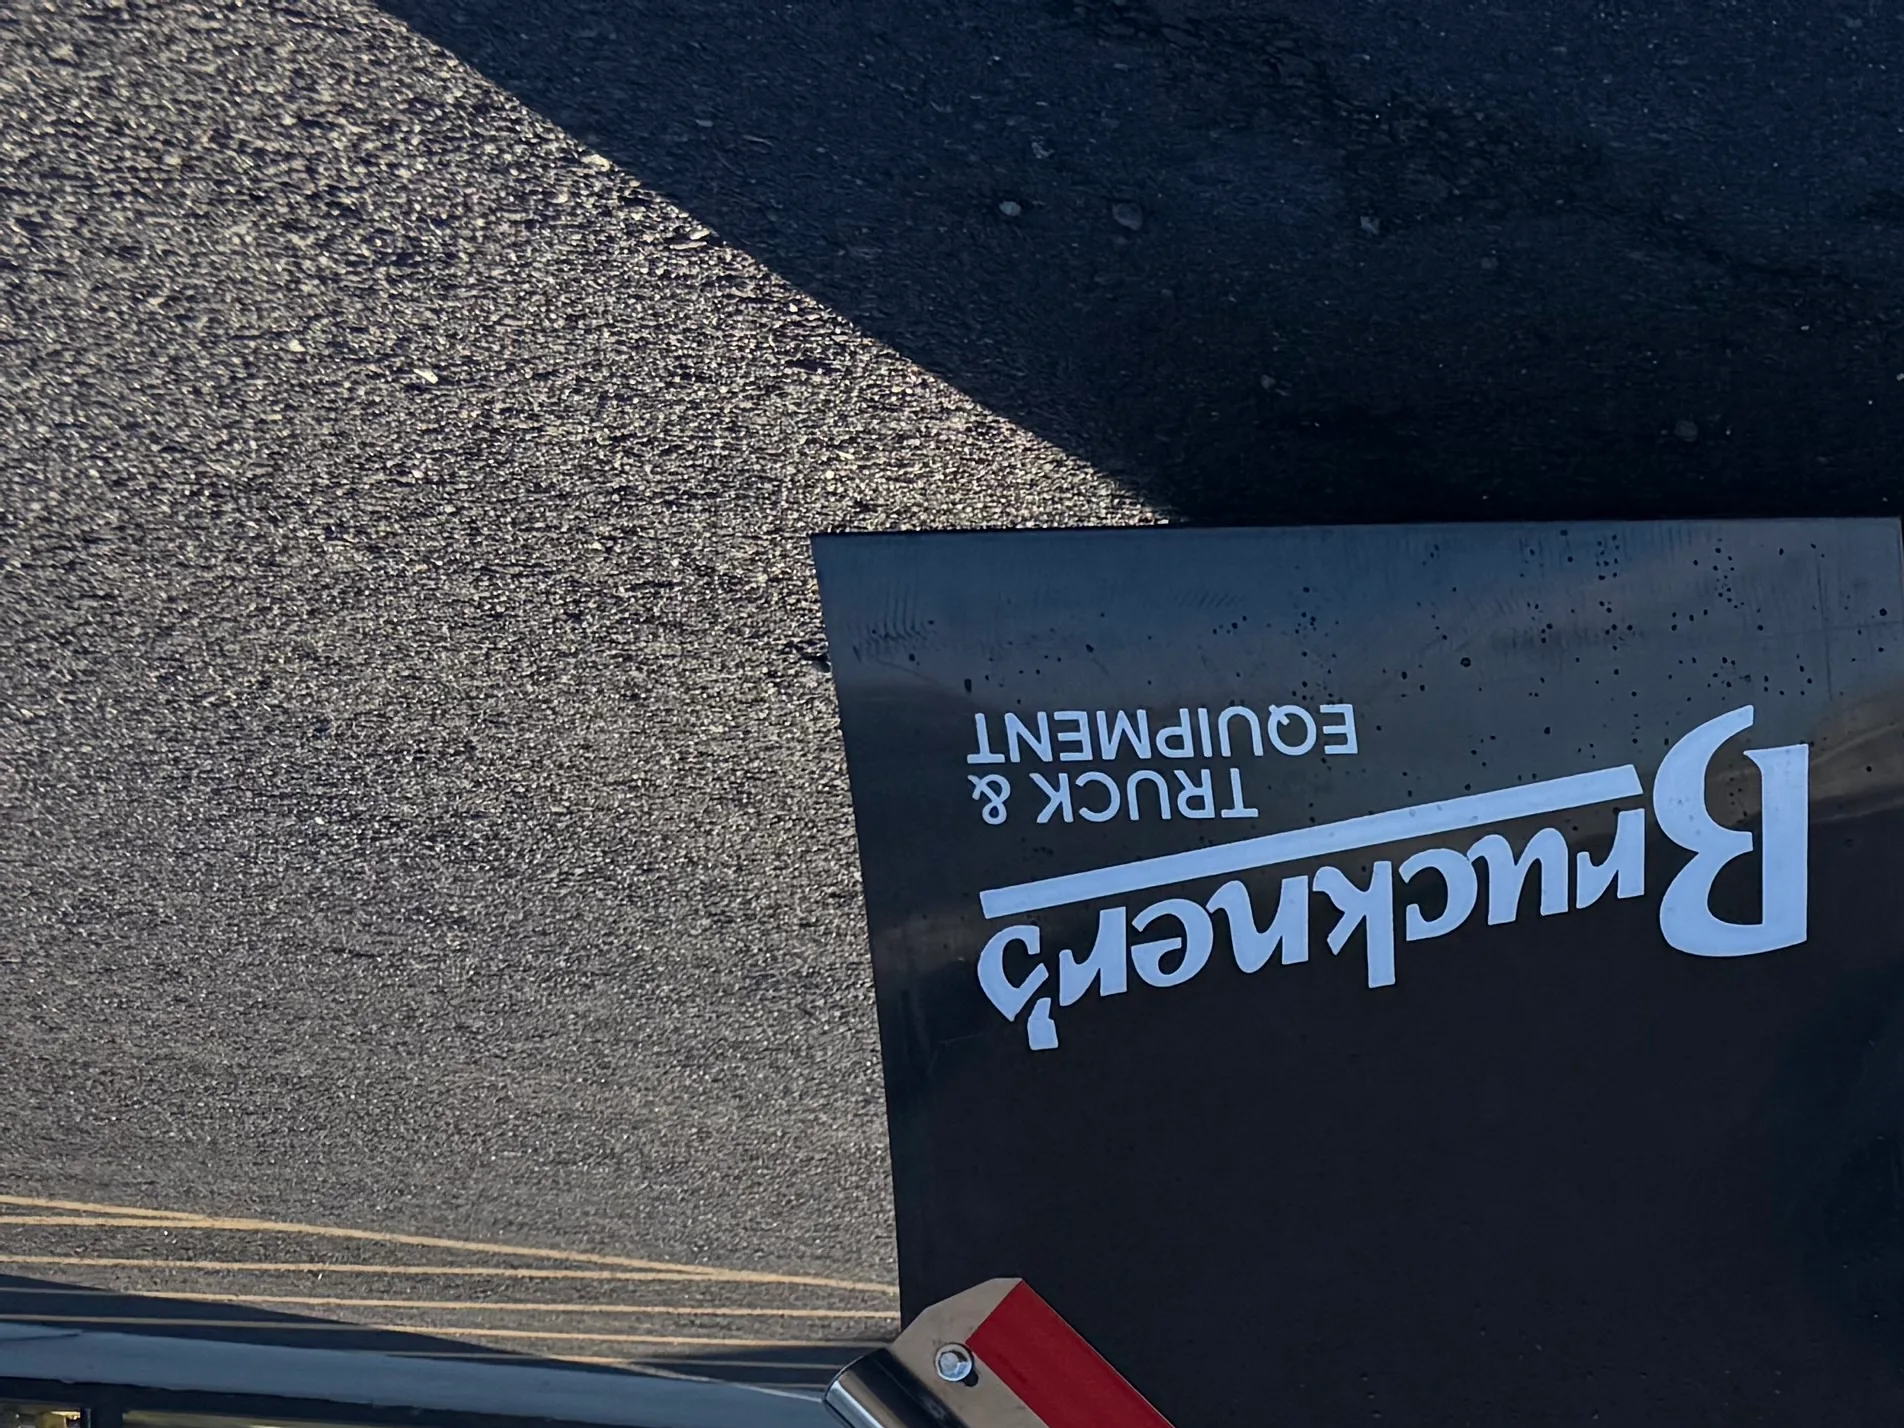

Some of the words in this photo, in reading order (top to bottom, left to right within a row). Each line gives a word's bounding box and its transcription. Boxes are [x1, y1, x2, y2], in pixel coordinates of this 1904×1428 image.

[967, 704, 1358, 763] EQUIPMENT
[967, 774, 1011, 825] &
[1030, 768, 1258, 824] TRUCK
[977, 703, 1810, 1052] Bruckner's
